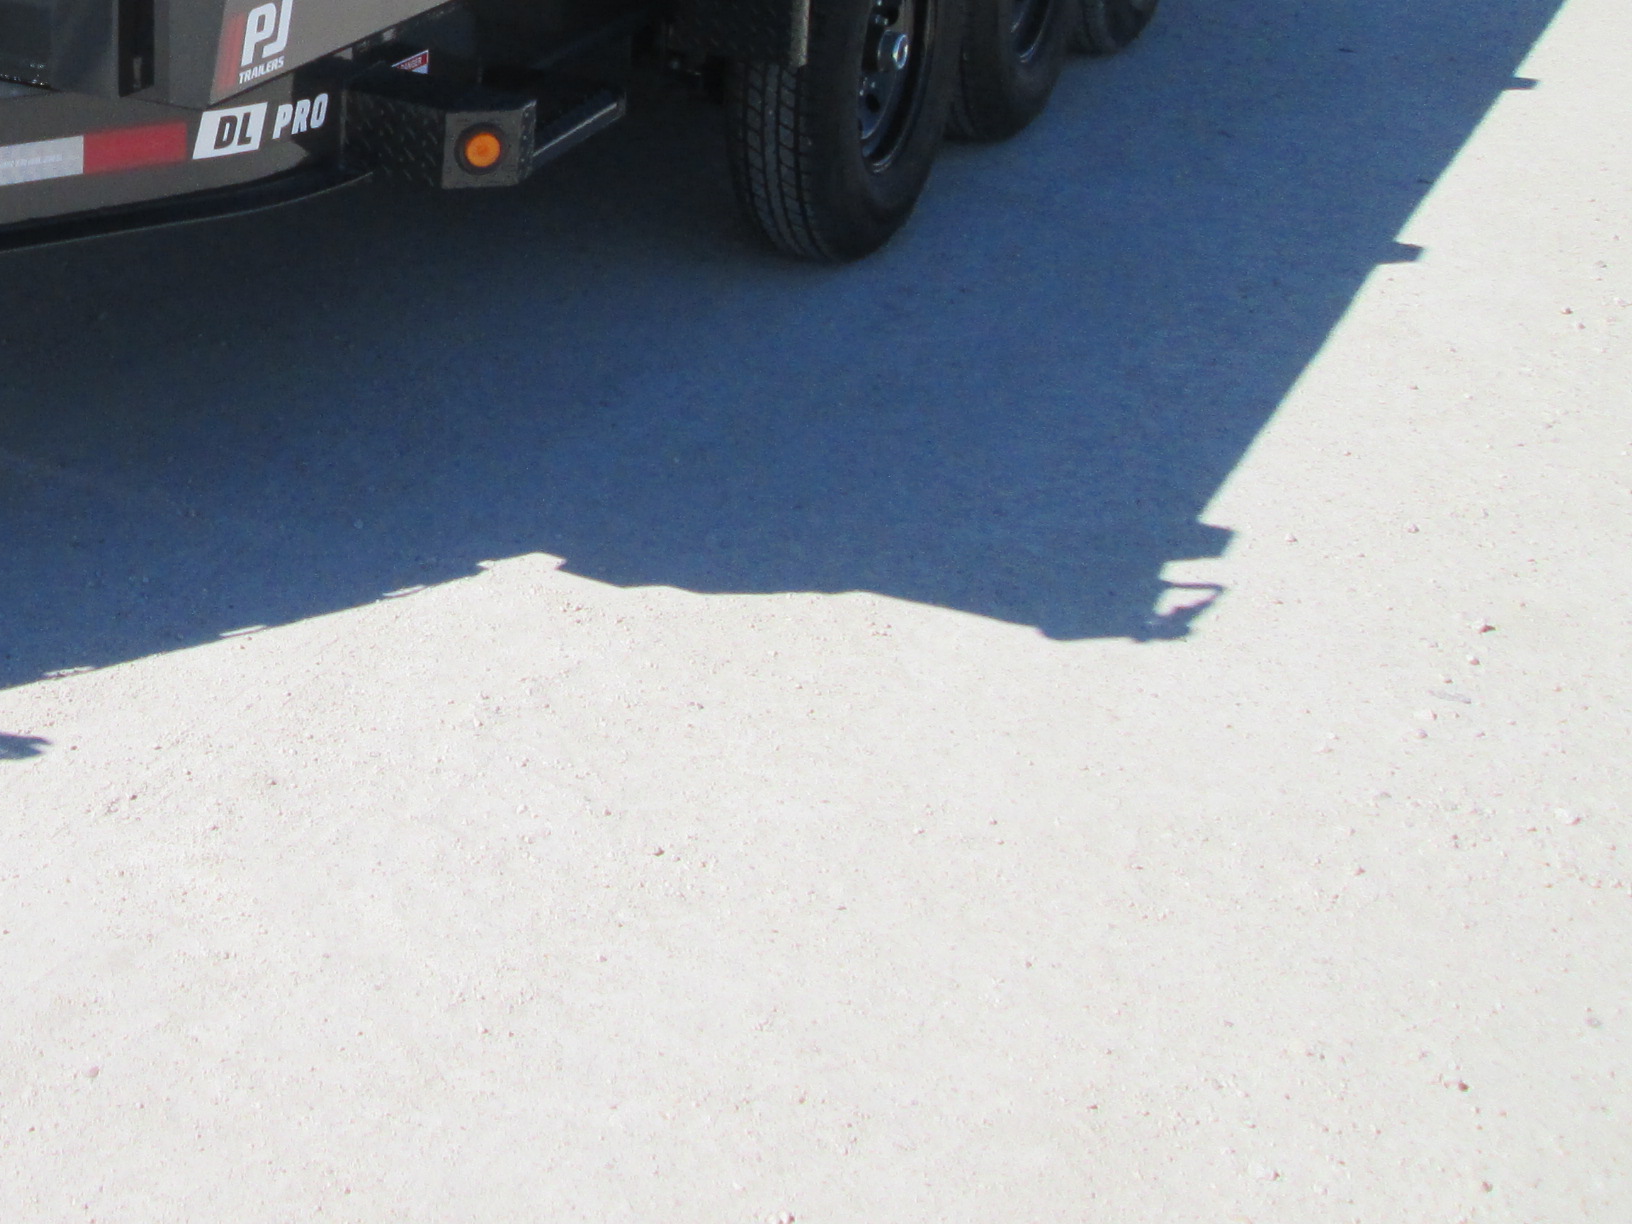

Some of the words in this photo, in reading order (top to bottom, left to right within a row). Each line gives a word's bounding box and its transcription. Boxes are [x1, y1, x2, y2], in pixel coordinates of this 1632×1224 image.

[239, 56, 284, 84] TRAILERS
[213, 111, 252, 150] DL
[272, 93, 329, 140] PRO
